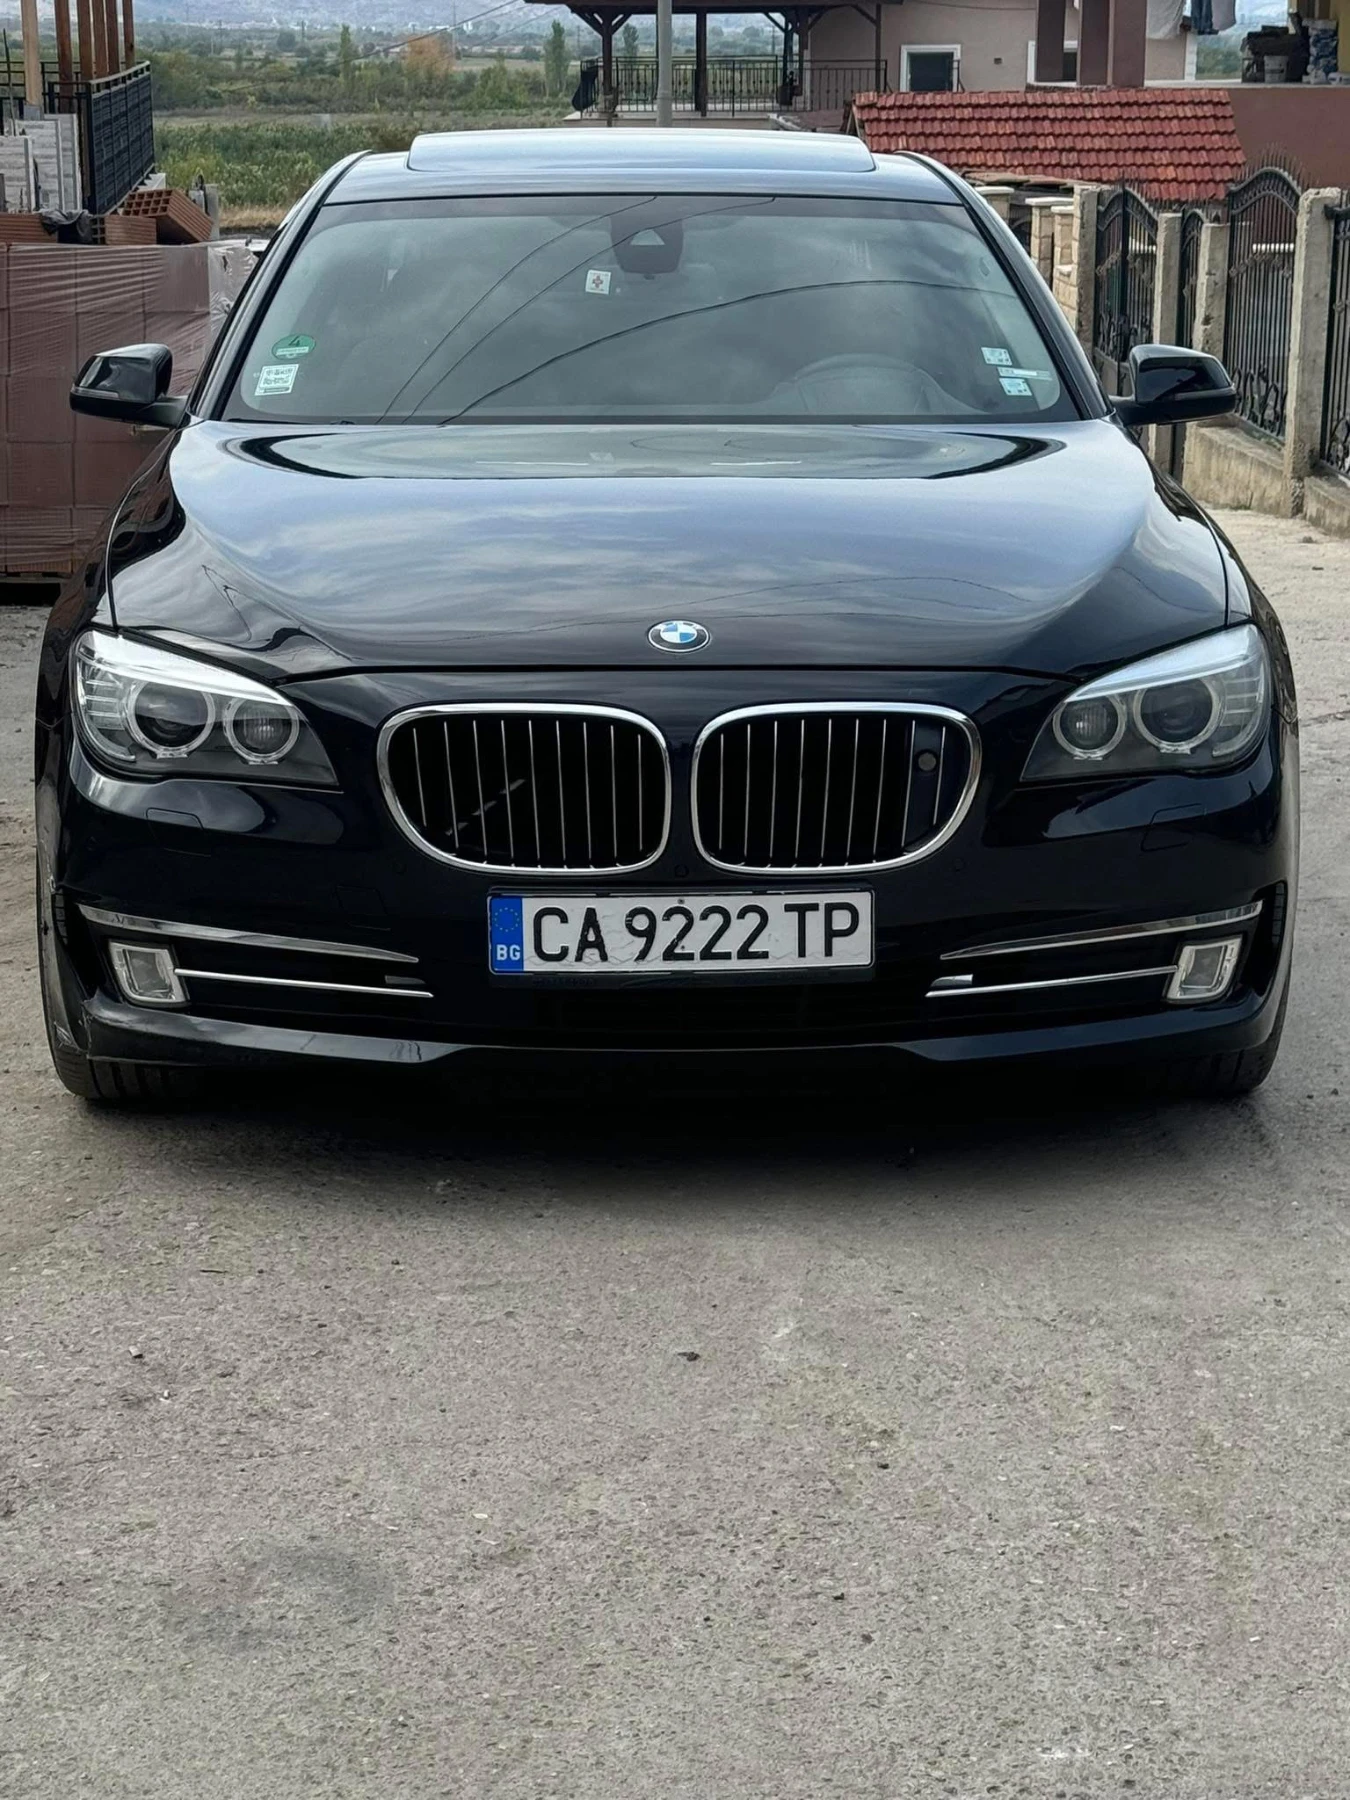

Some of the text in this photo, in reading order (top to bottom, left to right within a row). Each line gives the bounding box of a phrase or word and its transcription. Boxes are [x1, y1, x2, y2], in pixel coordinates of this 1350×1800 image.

[533, 902, 860, 962] CA 9222 TP
[496, 945, 521, 961] BG
